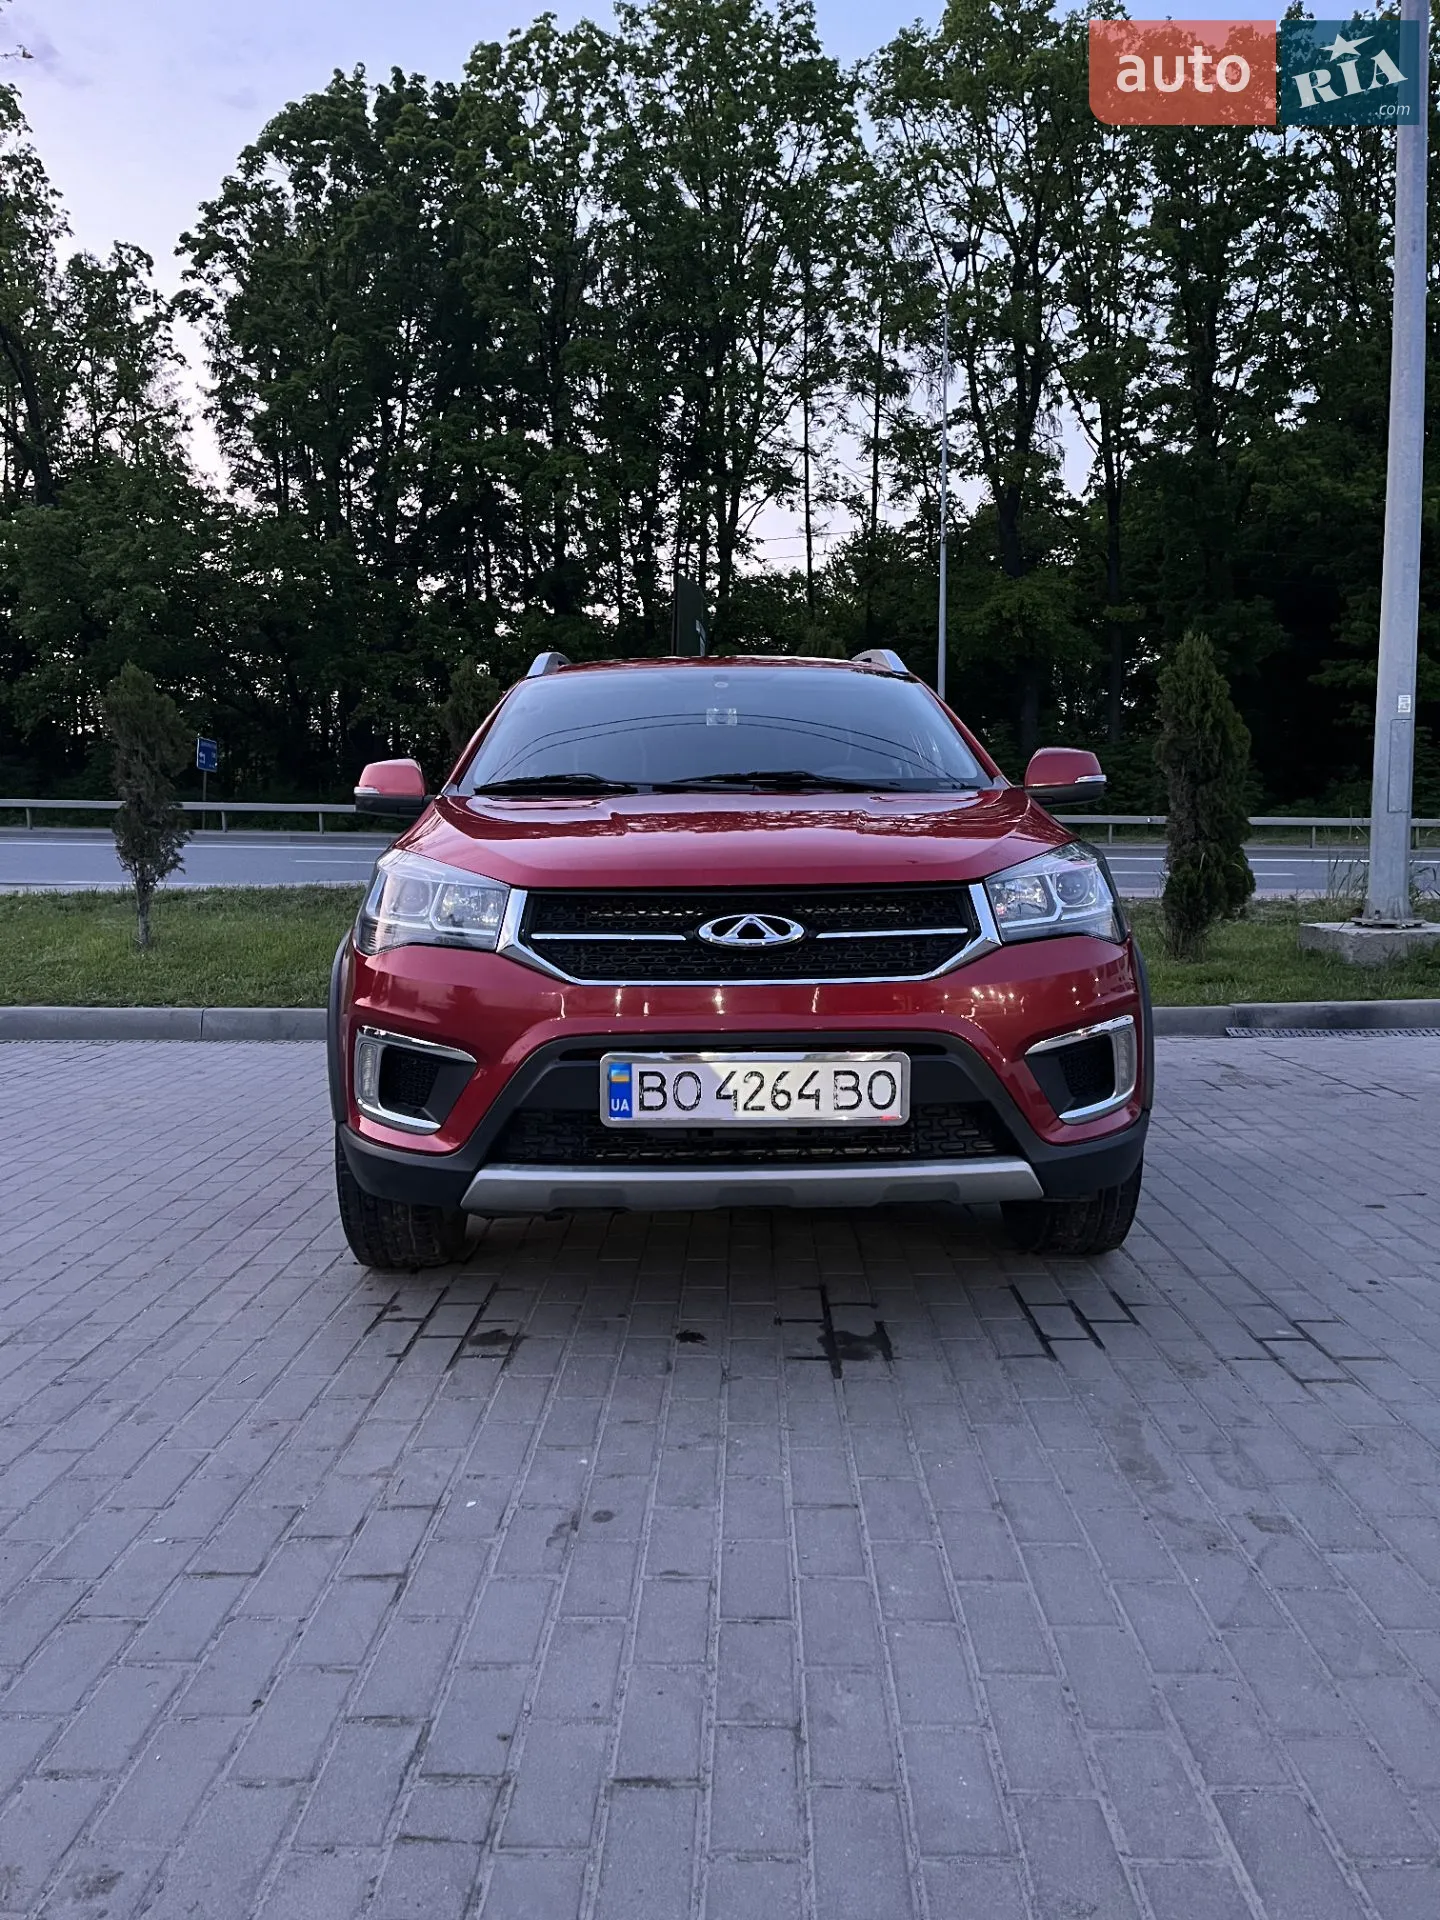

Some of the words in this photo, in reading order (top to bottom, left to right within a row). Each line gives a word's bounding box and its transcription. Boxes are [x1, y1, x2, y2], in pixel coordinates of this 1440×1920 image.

[638, 1070, 702, 1111] BO
[715, 1070, 821, 1111] 4264
[833, 1070, 898, 1111] BO
[610, 1098, 631, 1112] UA
